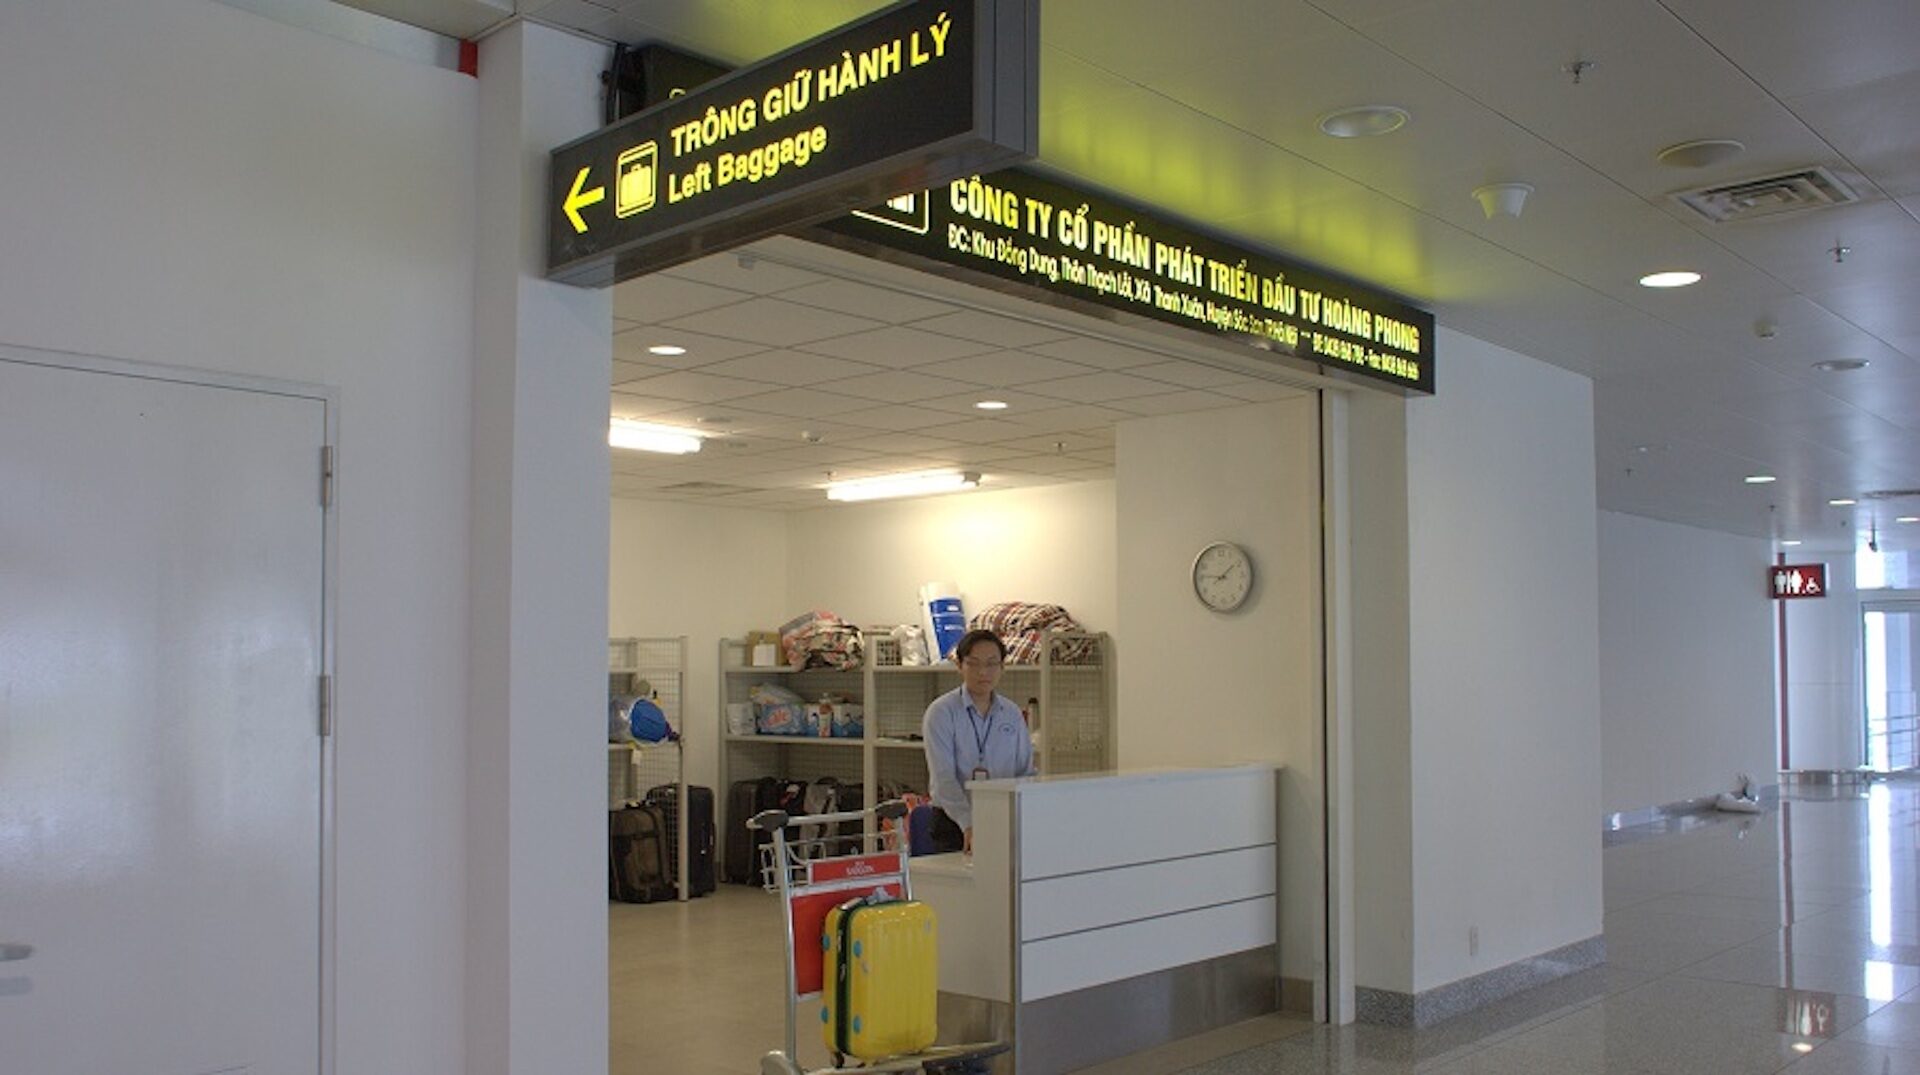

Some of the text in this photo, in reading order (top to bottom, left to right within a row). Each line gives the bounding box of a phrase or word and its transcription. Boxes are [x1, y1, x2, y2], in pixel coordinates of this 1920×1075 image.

[670, 12, 953, 158] TRÔNG GIỮ HÀNH LÝ
[668, 125, 828, 203] Left Baggage
[948, 223, 972, 252] ĐC:
[972, 229, 996, 261] Khu
[1154, 284, 1181, 314] Thanh
[950, 174, 1420, 354] CÔNG TY CỔ PHẦN PHÁT TRIỂN ĐẦU TƯ HOÀNG PHONG
